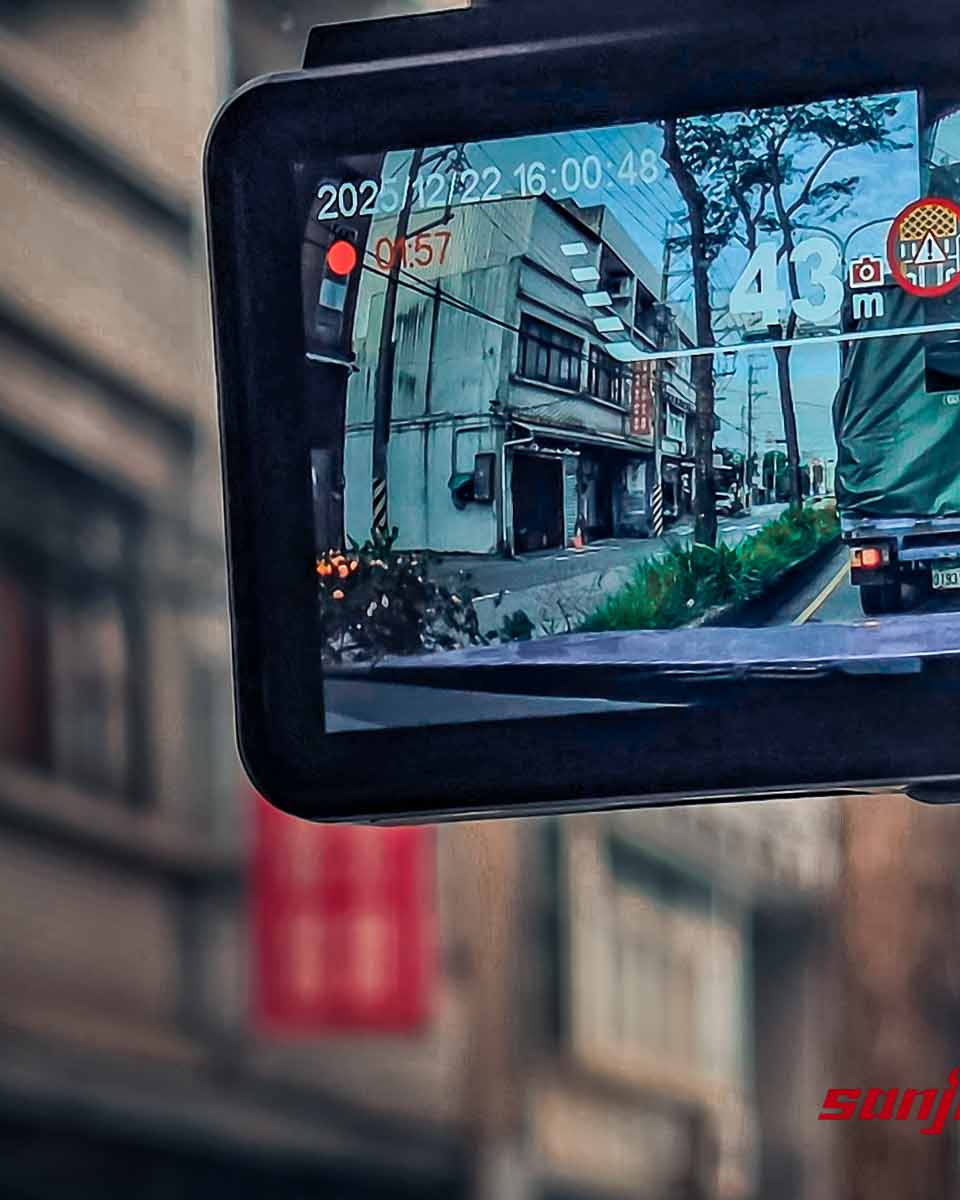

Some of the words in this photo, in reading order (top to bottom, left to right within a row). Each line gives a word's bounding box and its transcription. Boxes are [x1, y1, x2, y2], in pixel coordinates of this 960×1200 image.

[515, 149, 660, 197] 16:00:48
[375, 231, 452, 269] 01:57
[730, 237, 845, 328] 43
[851, 291, 885, 320] m
